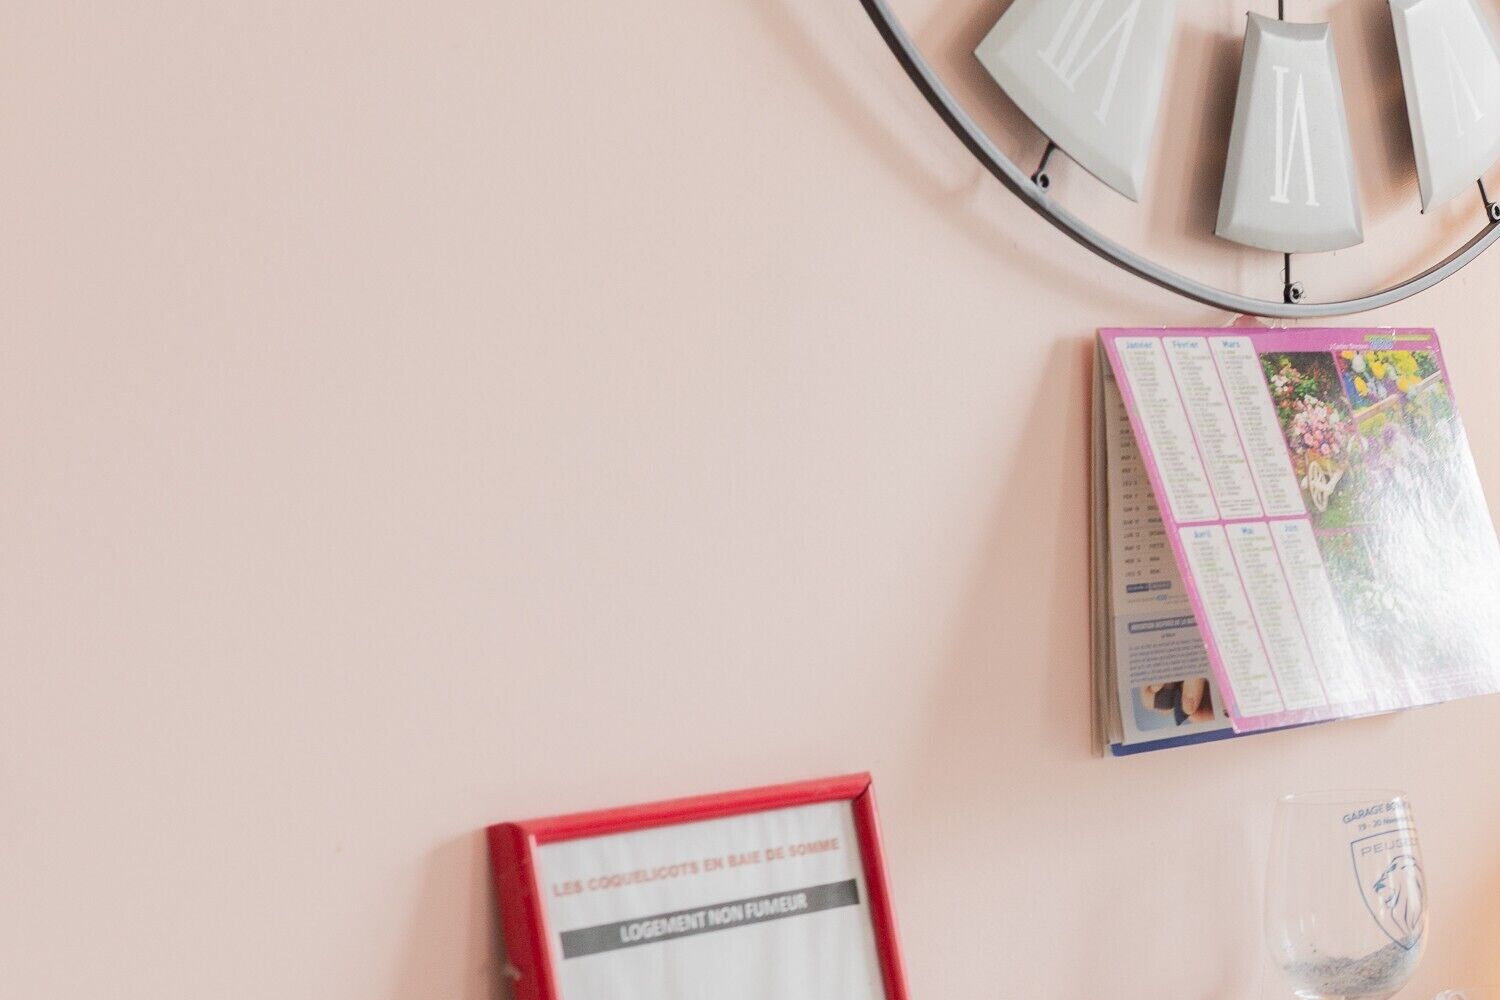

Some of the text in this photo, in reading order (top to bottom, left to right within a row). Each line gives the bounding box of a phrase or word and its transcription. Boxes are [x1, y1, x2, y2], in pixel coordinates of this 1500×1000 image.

[553, 837, 840, 898] LES COQUELICOTS EN BAIE DE SOMME
[619, 892, 809, 943] LOGEMENT NON FUMEUR
